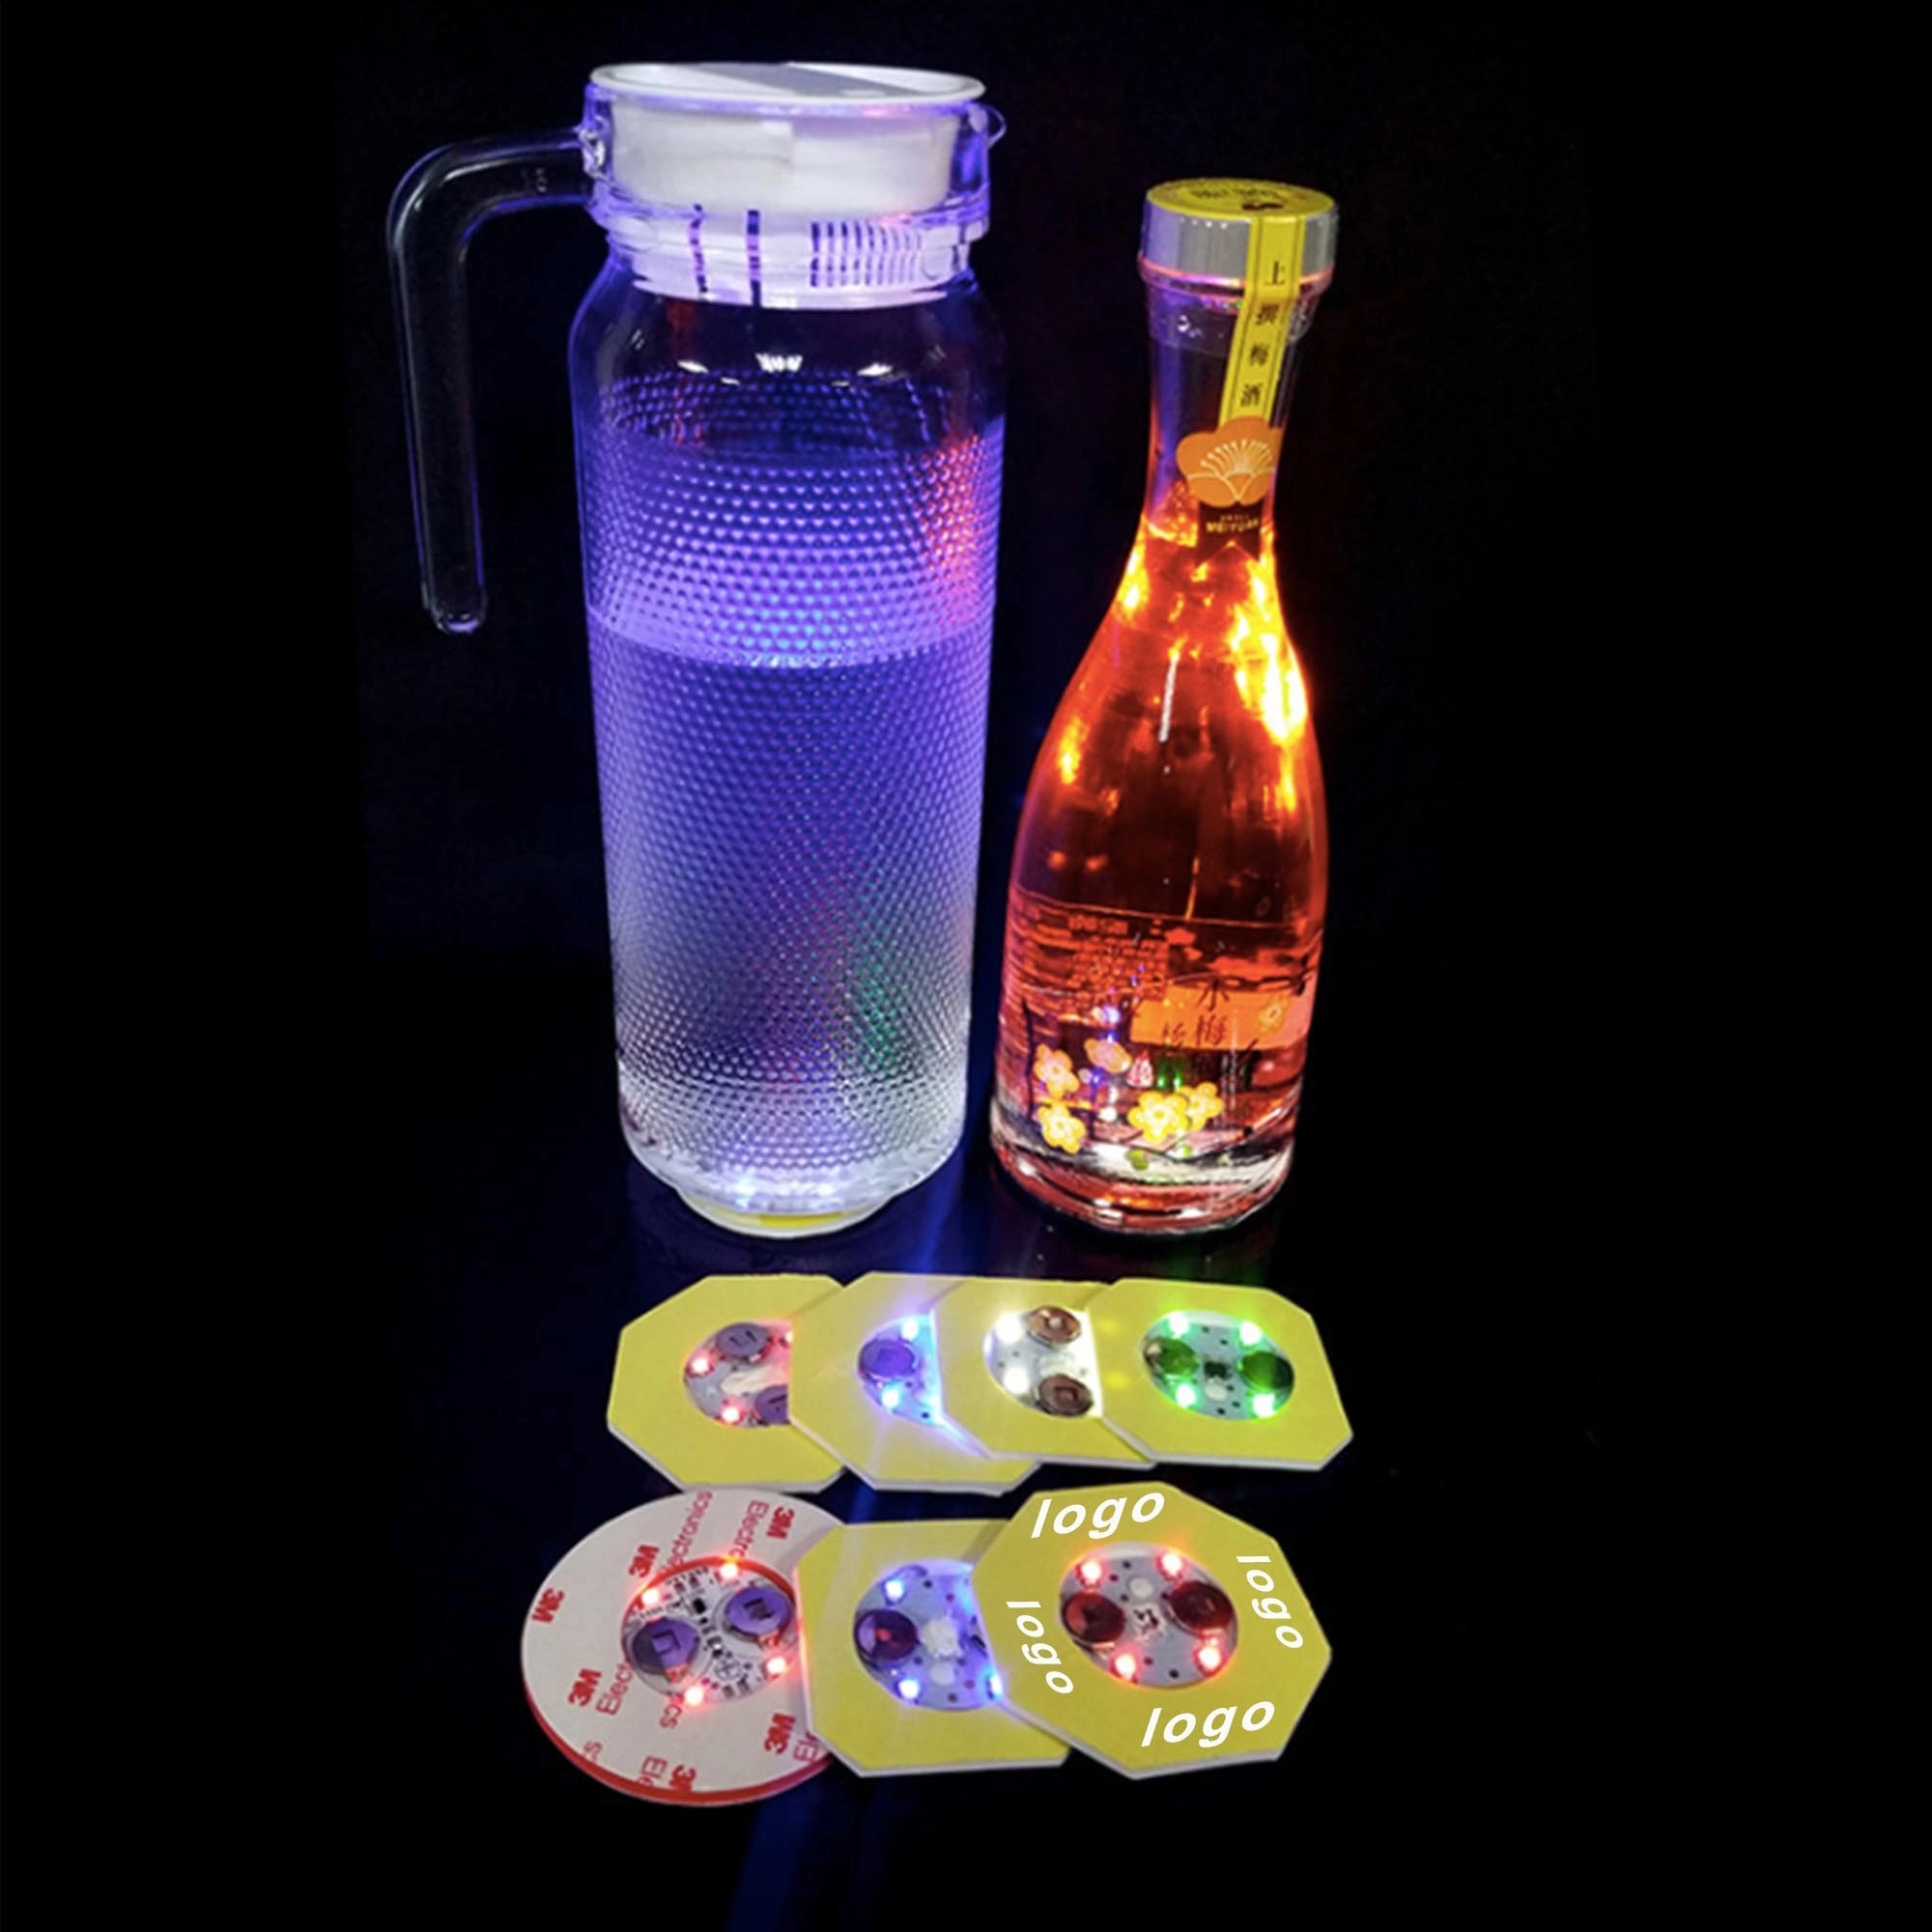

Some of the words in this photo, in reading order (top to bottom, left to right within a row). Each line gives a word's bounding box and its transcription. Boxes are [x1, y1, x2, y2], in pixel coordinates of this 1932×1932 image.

[766, 1506, 795, 1540] 3M
[629, 1545, 660, 1578] 3M
[531, 1588, 565, 1623] 3M
[567, 1668, 603, 1707] 3M
[764, 1713, 796, 1754] 3M
